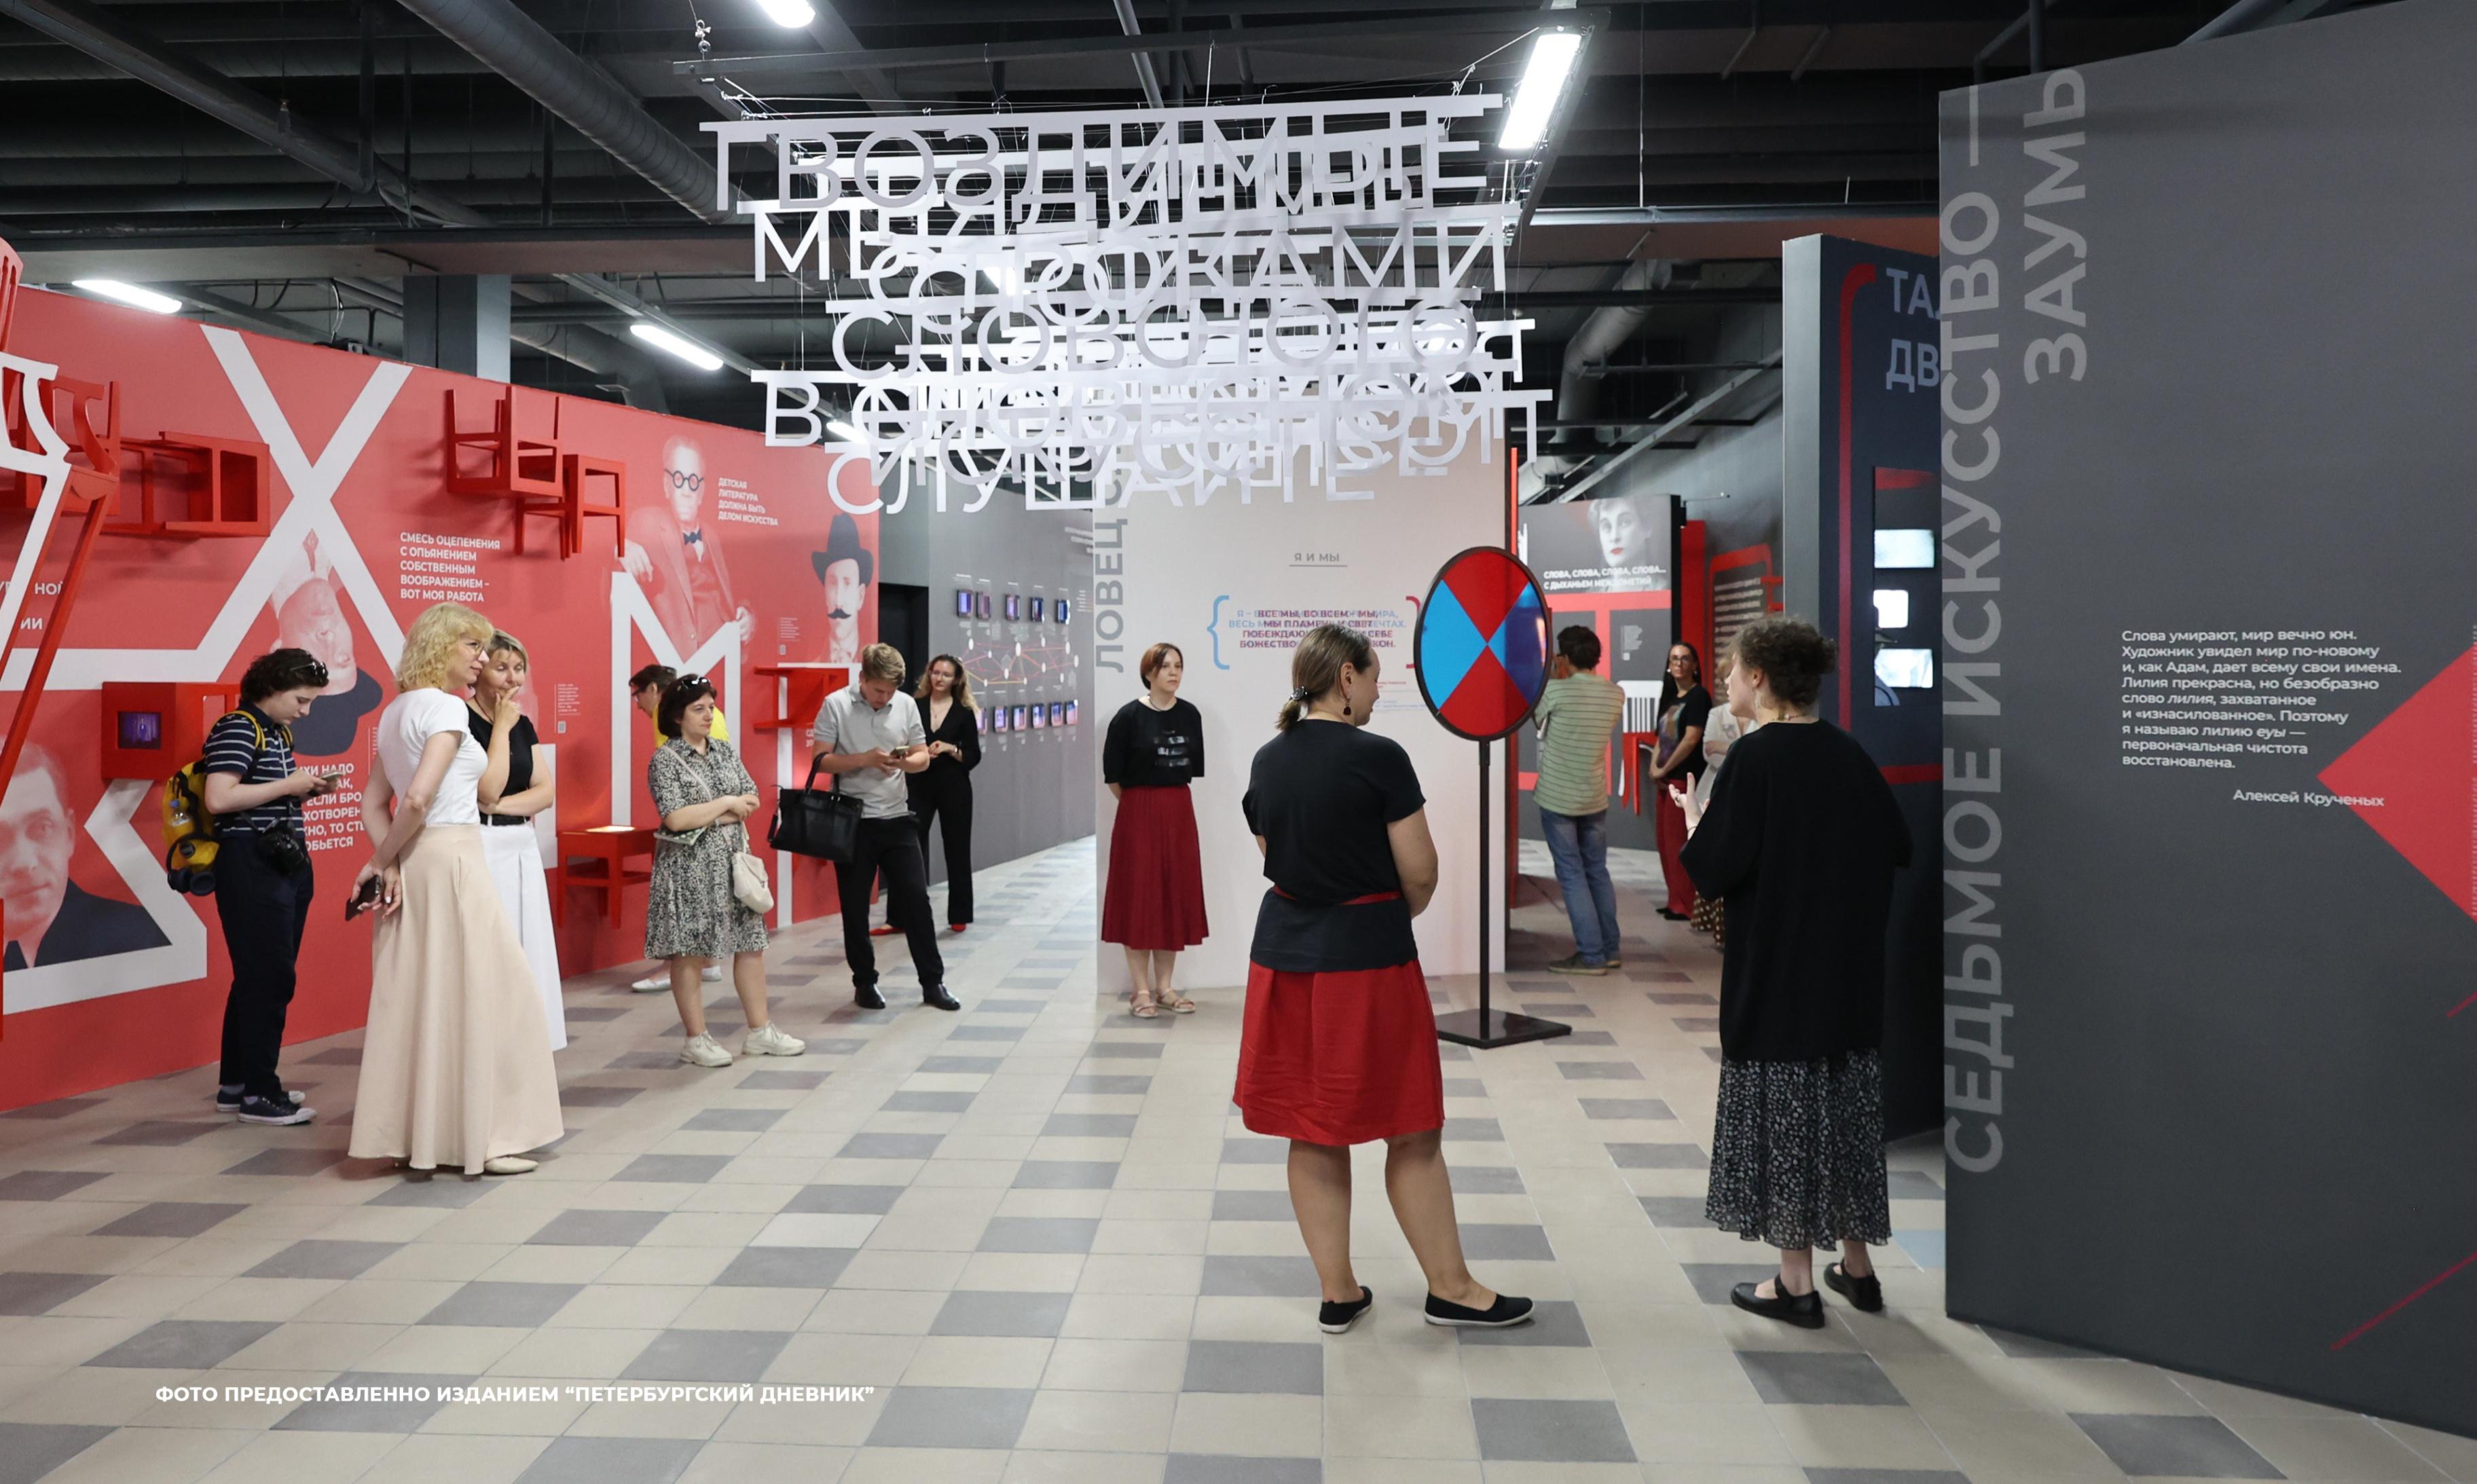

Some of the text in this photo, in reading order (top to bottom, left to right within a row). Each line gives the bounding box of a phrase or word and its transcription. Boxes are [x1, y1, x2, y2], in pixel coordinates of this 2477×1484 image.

[2023, 68, 2087, 385] ЗАУМЬ
[1886, 267, 1941, 320] ТА
[1939, 191, 2002, 716] ИСКУССТВО
[718, 477, 748, 489] ДЕТСКАЯ
[718, 488, 759, 502] ЛИТЕРАТУРА
[718, 499, 767, 514] ДОЛЖНА БЫТЬ
[718, 510, 779, 526] ДЕЛОМ ИСКУССТВА
[400, 532, 500, 550] СМЕСЬ ОЦЕПЕНЕНИЯ
[400, 546, 477, 562] С ОПЬЯНЕНИЕМ
[1294, 553, 1340, 562] Я И МЫ
[400, 560, 475, 575] СОБСТВЕННЫМ
[400, 574, 483, 589] ВООБРАЖЕНИЕМ
[401, 589, 484, 603] ВОТ МОЯ РАБОТА
[1095, 519, 1128, 673] ЛОВЕЦ
[2121, 630, 2357, 644] Слова умирают, мир вечно юн.
[2121, 646, 2381, 660] Художник увидел мир по-новому
[2122, 661, 2402, 675] и, как Адам, дает всему свои имена.
[2121, 676, 2380, 692] Лилия прекрасна, но безобразно
[2121, 694, 2317, 706] слово лилия, захватанное
[2122, 709, 2349, 724] и «изнасилованное». Поэтому
[2121, 725, 2131, 734] я
[2134, 726, 2199, 736] называю
[2201, 726, 2254, 737] лилию
[2256, 728, 2287, 740] еуы
[2122, 740, 2309, 755] первоначальная чистота
[2122, 756, 2236, 768] восстановлена.
[2233, 789, 2385, 807] Алексей Крученых
[1943, 747, 2015, 1173] СЕДЬМОЕ
